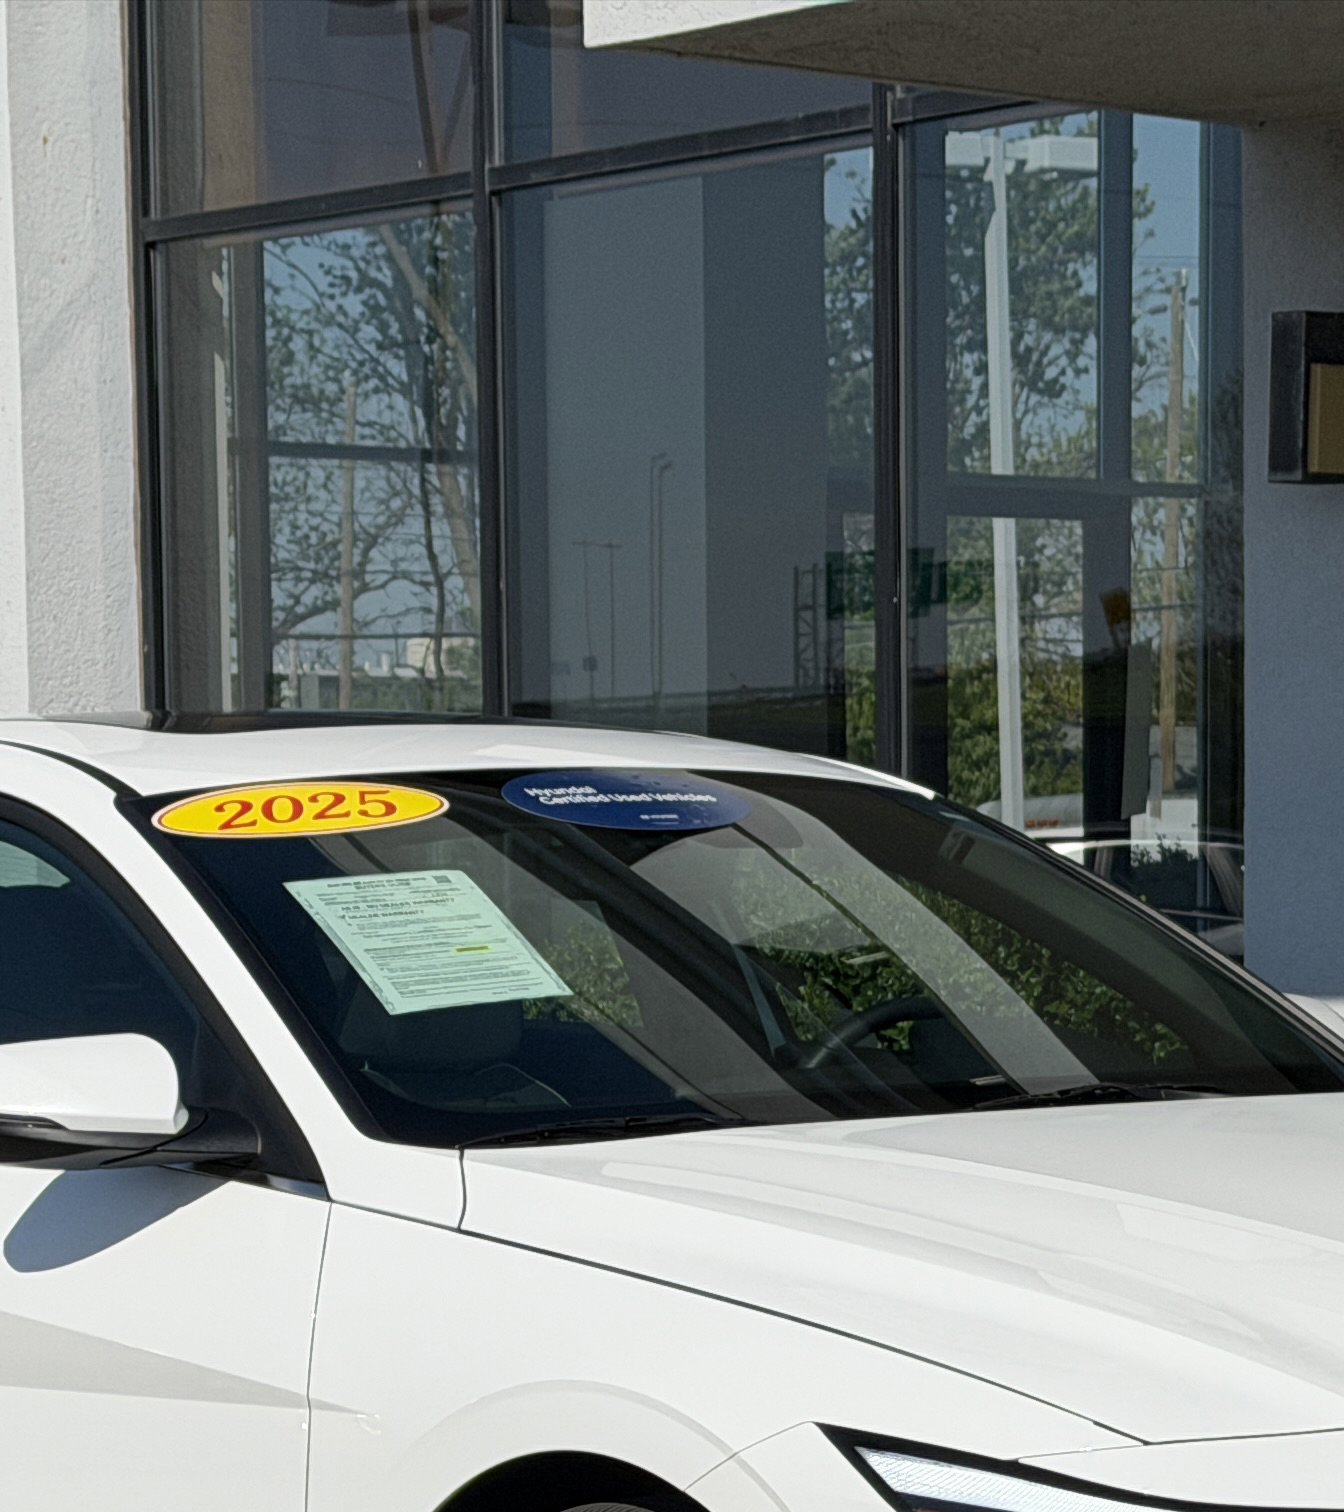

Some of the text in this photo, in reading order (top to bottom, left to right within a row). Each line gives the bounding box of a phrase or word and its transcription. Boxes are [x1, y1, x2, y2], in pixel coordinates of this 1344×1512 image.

[524, 786, 597, 796] Hyundai
[539, 793, 717, 804] Certified Used Vehicles
[214, 790, 397, 830] 2025
